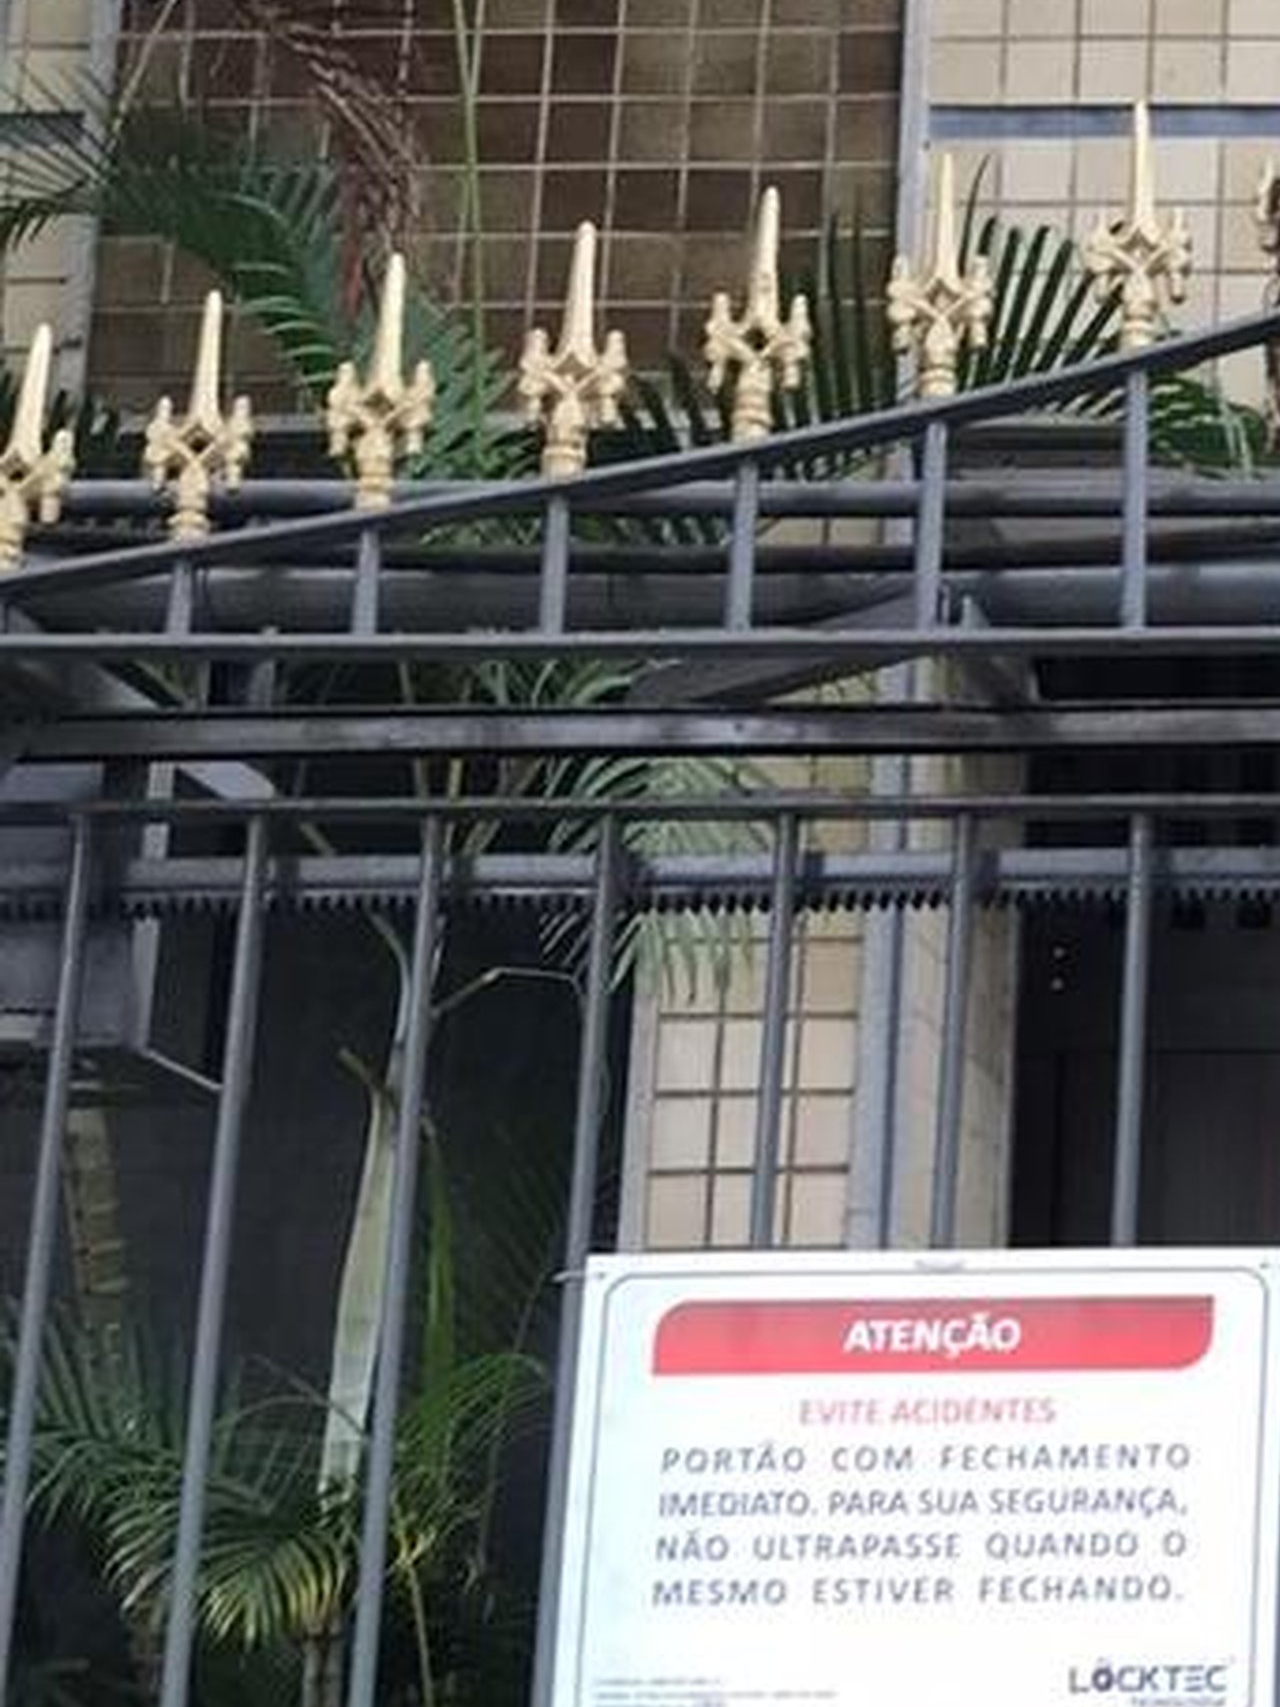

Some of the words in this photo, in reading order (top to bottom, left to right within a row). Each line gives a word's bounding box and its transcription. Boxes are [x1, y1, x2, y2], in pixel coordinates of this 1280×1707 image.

[842, 1314, 1021, 1356] ATENÇÃO
[800, 1401, 885, 1424] EVITE
[891, 1398, 1056, 1423] ACIDENTES
[661, 1442, 806, 1473] PORTÃO
[834, 1446, 914, 1471] COM
[941, 1443, 1191, 1470] FECHAMENTO
[659, 1491, 818, 1518] IMEDIATO.
[829, 1492, 910, 1516] PARA
[918, 1490, 979, 1515] SUA
[989, 1489, 1188, 1518] SEGURANÇA,
[657, 1533, 729, 1562] NÃO
[754, 1533, 961, 1560] ULTRAPASSE
[986, 1532, 1138, 1560] QUANDO
[1164, 1532, 1186, 1557] O
[653, 1579, 787, 1606] MESMO
[814, 1578, 954, 1604] ESTIVER
[981, 1576, 1184, 1603] FECHANDO.
